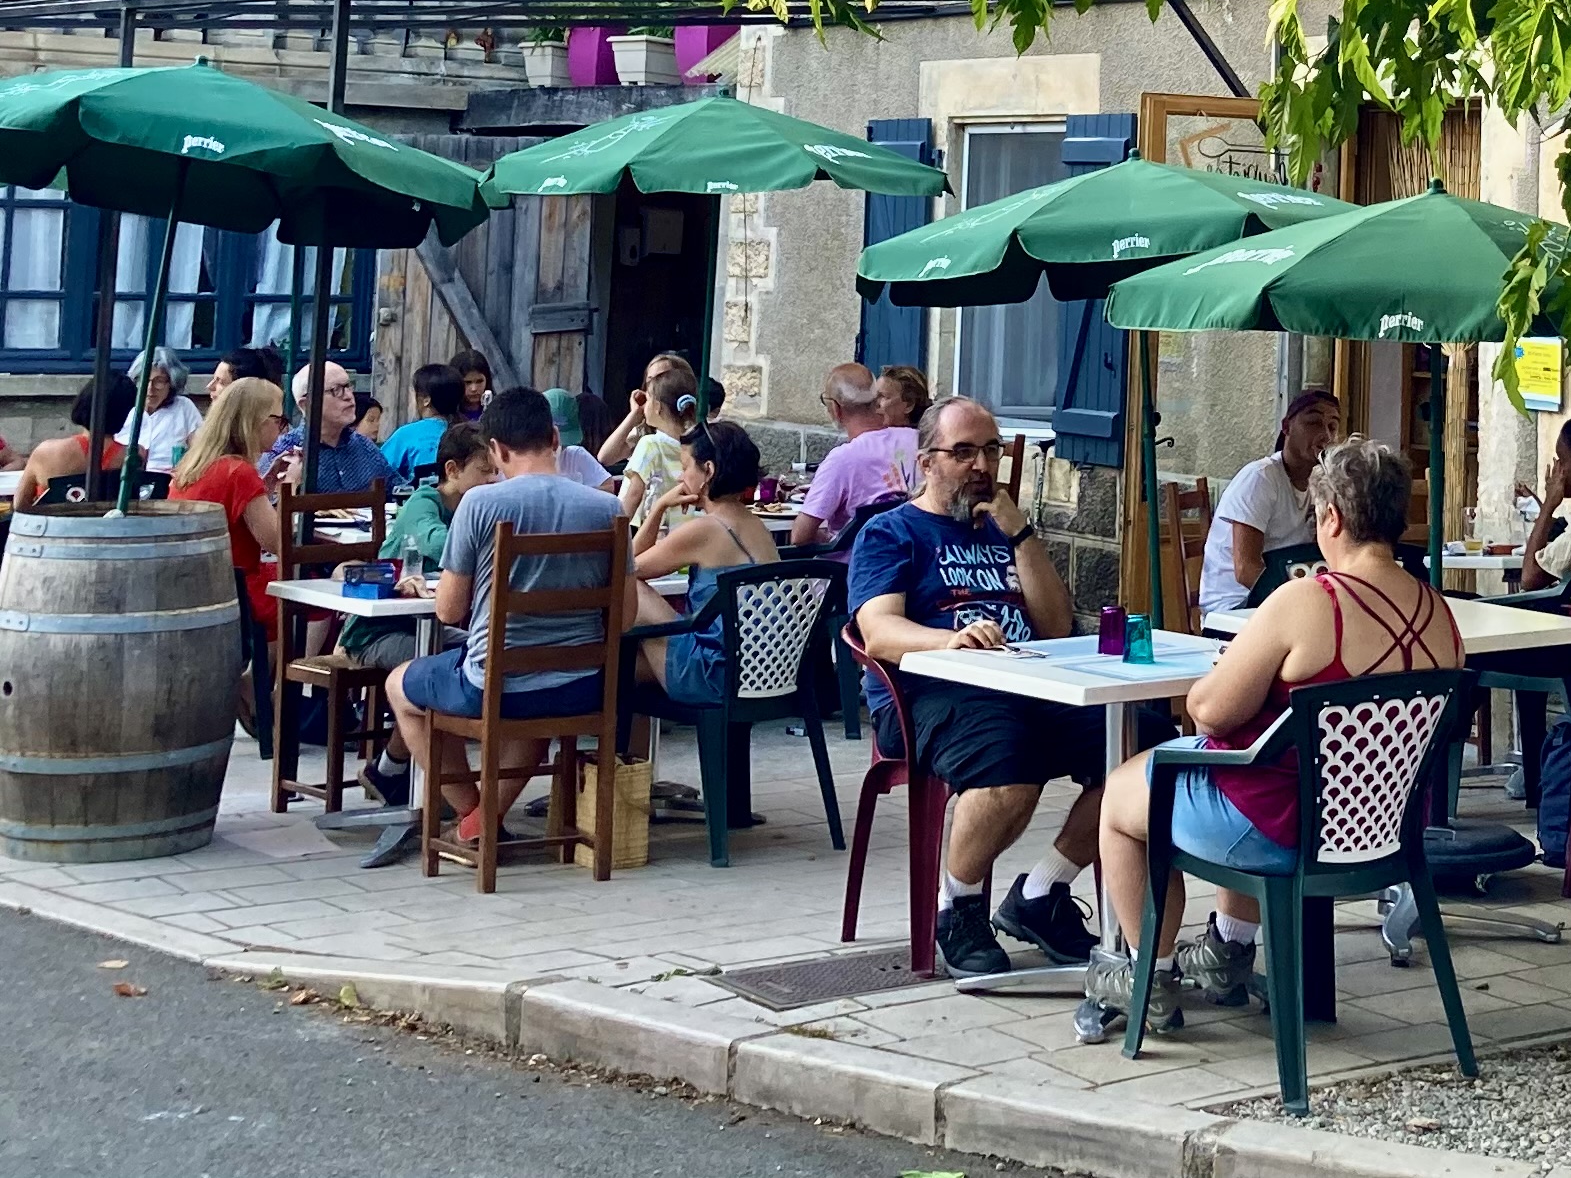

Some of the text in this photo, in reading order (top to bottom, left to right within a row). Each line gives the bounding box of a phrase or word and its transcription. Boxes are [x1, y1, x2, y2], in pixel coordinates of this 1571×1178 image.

[939, 542, 1011, 565] ALWAYS
[939, 567, 1005, 591] LOOK ON
